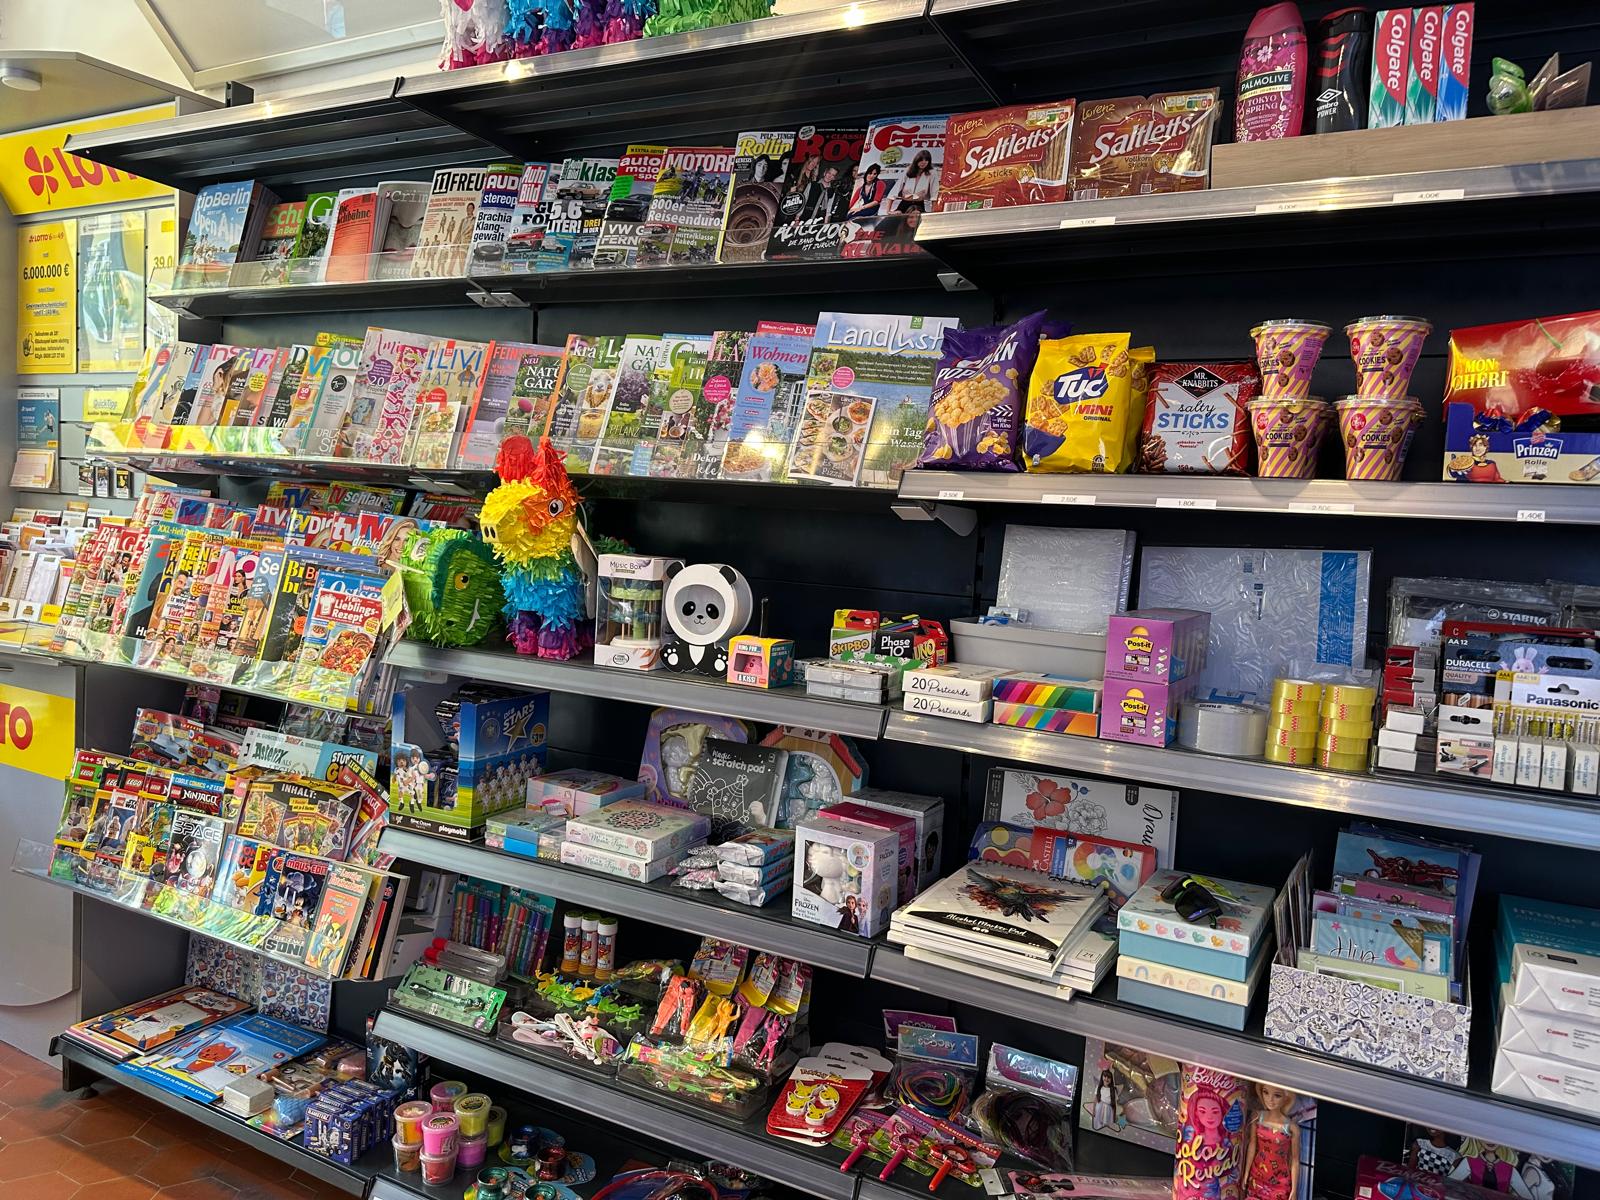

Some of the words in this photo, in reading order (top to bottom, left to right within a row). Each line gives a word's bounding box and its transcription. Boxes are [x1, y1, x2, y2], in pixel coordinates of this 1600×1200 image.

[1420, 12, 1439, 82] Colgate
[1452, 9, 1470, 75] Colgate
[1387, 14, 1407, 91] Colgate
[1241, 74, 1289, 92] PALMOLIVE
[1247, 95, 1277, 105] TOKYO
[1317, 102, 1339, 112] umbro
[1246, 103, 1278, 115] SPRING
[1317, 108, 1337, 118] POWER
[1089, 116, 1193, 164] Saltletts
[960, 127, 1056, 178] Saltletts
[620, 157, 661, 166] auto
[522, 166, 546, 184] Auto
[197, 188, 251, 209] tipBerlin
[518, 184, 542, 203] Bild
[550, 200, 583, 220] 5.6
[651, 199, 685, 211] 800er
[194, 209, 217, 236] Open
[478, 212, 512, 223] Brachia
[583, 219, 601, 228] DREI
[648, 210, 724, 227] Reiseenduros
[475, 221, 505, 233] Klang-
[548, 219, 581, 233] LITER!
[609, 223, 633, 235] VW
[774, 217, 824, 242] ALICE
[473, 232, 505, 242] gewalt
[674, 238, 698, 246] Nakeds
[813, 239, 838, 249] ZURÜCK!
[23, 264, 62, 280] 6.000.000
[64, 263, 70, 277] €
[751, 345, 808, 364] Wohnen
[1358, 356, 1386, 366] COOKIES
[370, 376, 385, 387] 20
[1182, 378, 1219, 388] KNABBITS
[1193, 372, 1207, 380] MR.
[1177, 399, 1215, 415] salty
[1157, 412, 1229, 429] STICKS
[904, 427, 922, 439] Tag
[1265, 432, 1293, 440] COOKIES
[1361, 434, 1391, 442] COOKIES
[1516, 443, 1559, 459] Prinzen
[345, 491, 385, 507] schlau
[1520, 512, 1543, 520] 1.40€
[358, 514, 393, 541] TV
[352, 536, 383, 548] direkt
[610, 561, 628, 570] Music
[334, 599, 379, 616] Lieblings-
[331, 609, 364, 623] Rezept
[1502, 611, 1547, 625] STABILO
[1452, 627, 1459, 636] C
[881, 636, 911, 648] Phase
[1127, 639, 1151, 649] Post-it
[889, 647, 904, 656] 10
[914, 639, 936, 661] UNO
[1446, 658, 1491, 670] DURACELL
[1445, 672, 1472, 680] QUALITY
[911, 677, 926, 690] 20
[927, 679, 970, 697] Postcards
[912, 697, 928, 710] 20
[928, 699, 972, 717] Postcards
[1122, 701, 1147, 711] Post-it
[1526, 693, 1599, 710] Panasonic
[503, 701, 535, 731] STARS
[253, 742, 288, 764] Asterix
[80, 768, 95, 777] LEGO
[712, 758, 746, 770] scratch
[747, 762, 765, 775] pad
[126, 778, 142, 787] LEGO
[183, 789, 218, 806] NINJAGO
[281, 784, 317, 798] INHALT:
[172, 820, 222, 842] SPACE
[438, 825, 467, 836] playmobil
[1039, 835, 1053, 871] CASTELL
[795, 899, 819, 912] FROZEN
[947, 913, 977, 925] Alcohol
[977, 920, 1007, 932] Marker
[1008, 928, 1027, 936] Pad
[1562, 987, 1585, 996] Canon
[1546, 1028, 1568, 1037] Canon
[1193, 1066, 1235, 1090] Barbie
[1537, 1074, 1560, 1083] Canon
[939, 1122, 977, 1146] MAGNIFYING
[1180, 1152, 1240, 1188] Reveal
